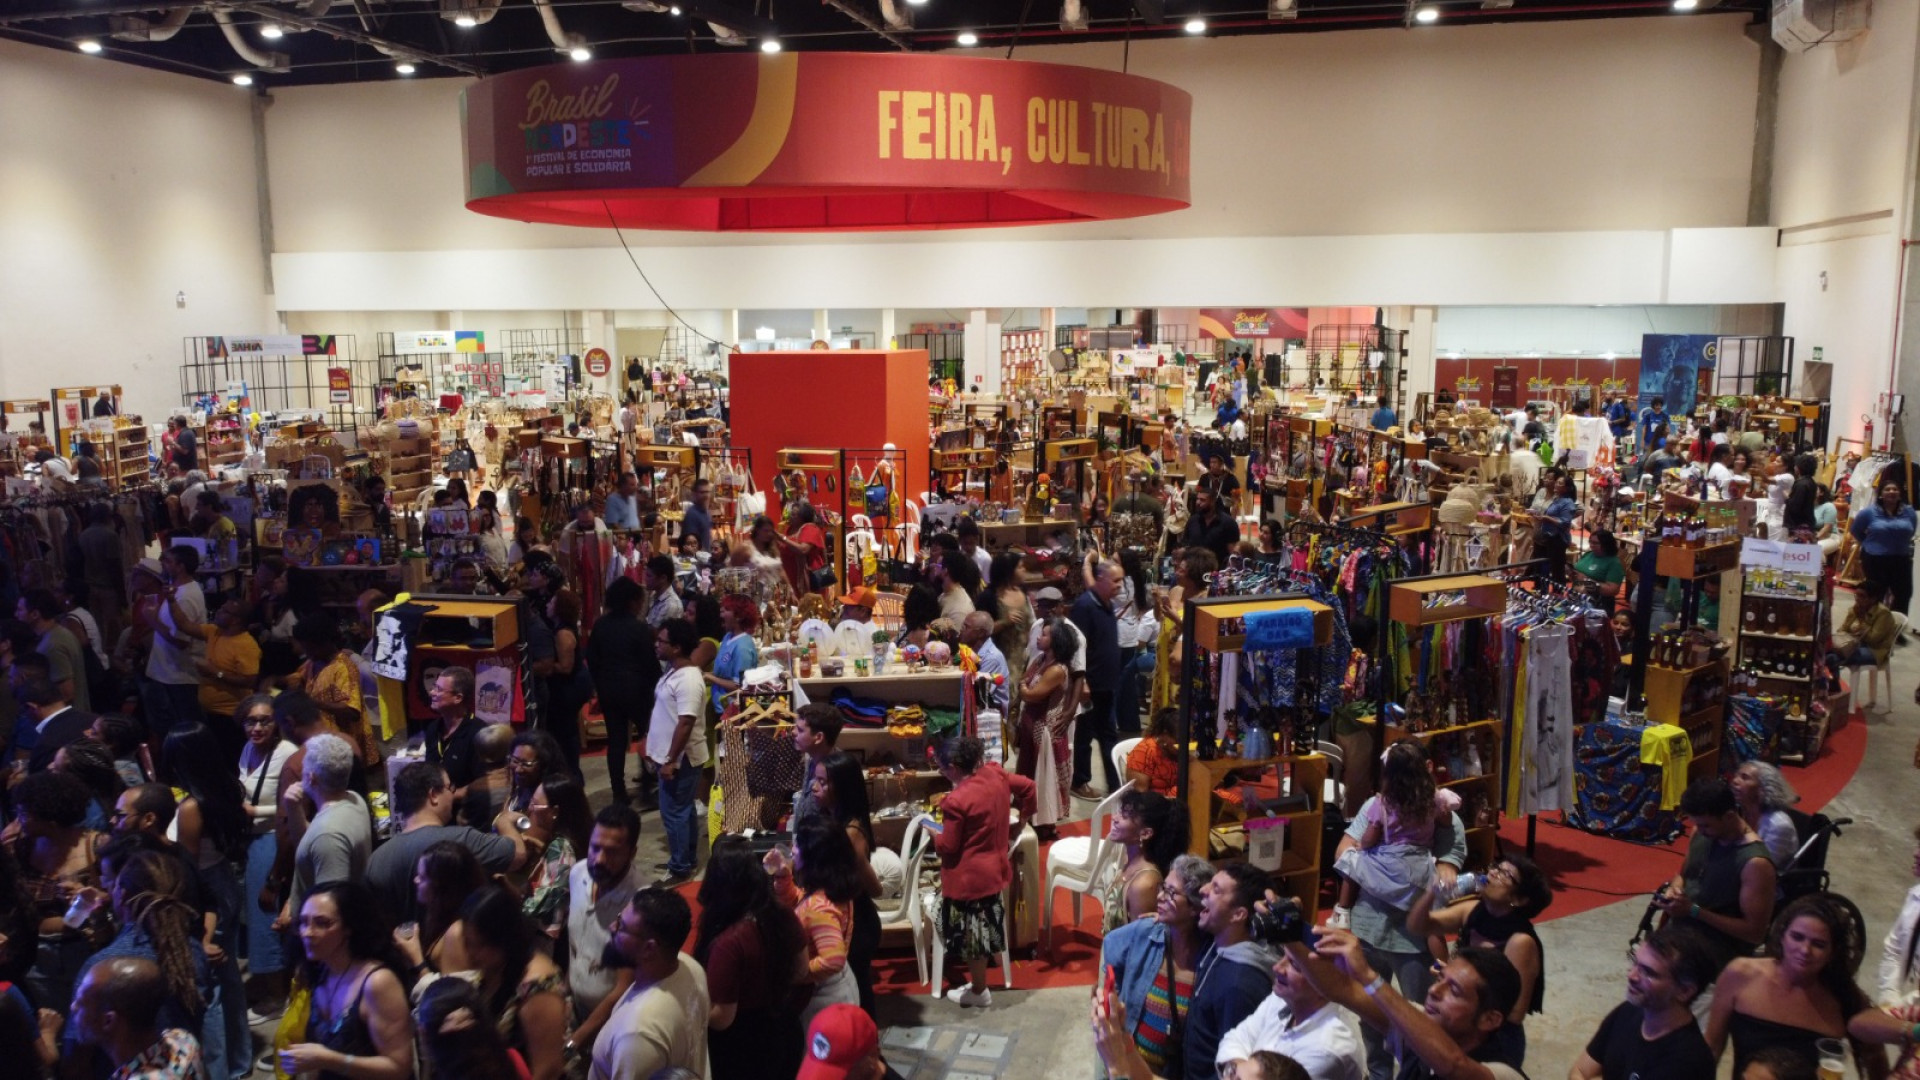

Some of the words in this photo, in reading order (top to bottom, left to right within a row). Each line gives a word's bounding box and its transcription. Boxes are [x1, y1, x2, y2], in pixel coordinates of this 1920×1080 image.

[518, 73, 619, 130] Brasil
[533, 152, 565, 163] FESTIVAL
[567, 151, 578, 160] DE
[580, 148, 632, 160] ECONOMIA
[878, 90, 1013, 176] FEIRA,
[1027, 96, 1170, 186] CULTURA,
[526, 164, 564, 176] POPULAR
